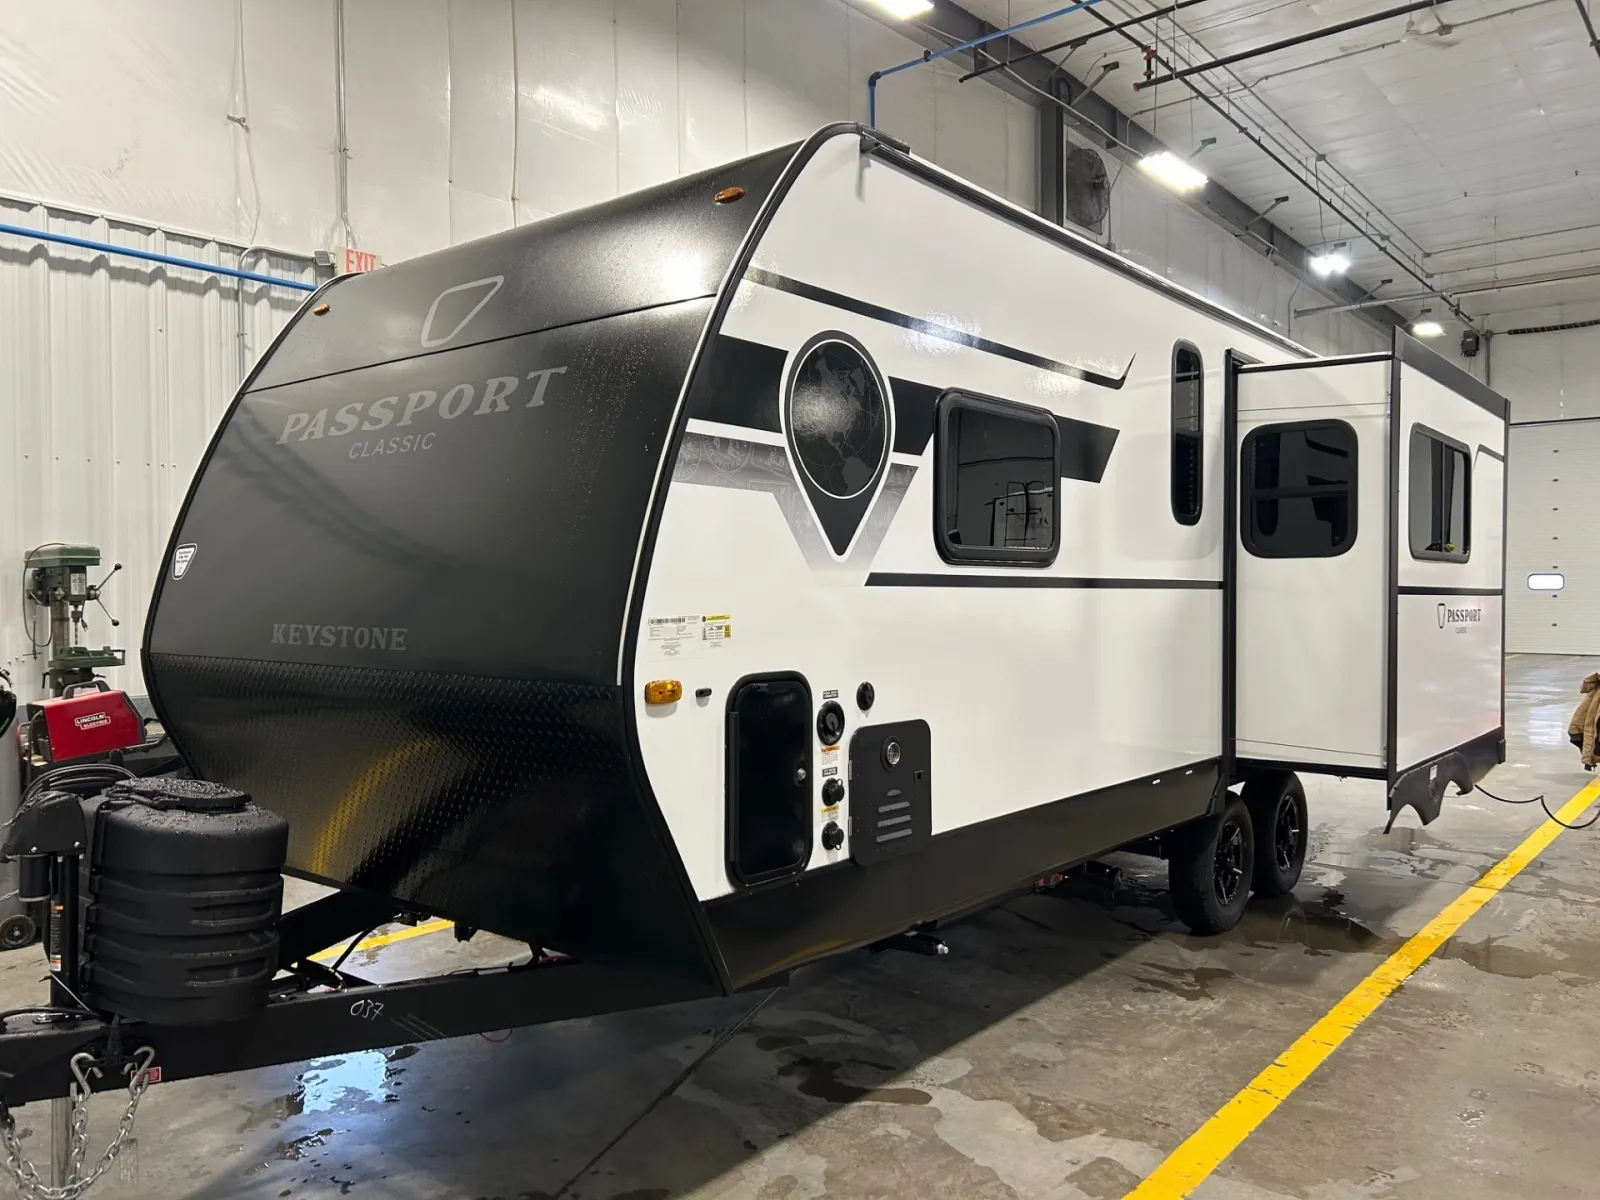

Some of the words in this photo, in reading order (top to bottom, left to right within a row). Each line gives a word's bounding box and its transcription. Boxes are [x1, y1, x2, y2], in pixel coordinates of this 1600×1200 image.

[346, 248, 376, 272] EXIT
[276, 366, 567, 445] PASSPORT
[349, 432, 436, 459] CLASSIC
[1447, 608, 1481, 623] PASSPORT
[271, 623, 409, 651] KEYSTONE
[76, 714, 105, 725] LINCOLN
